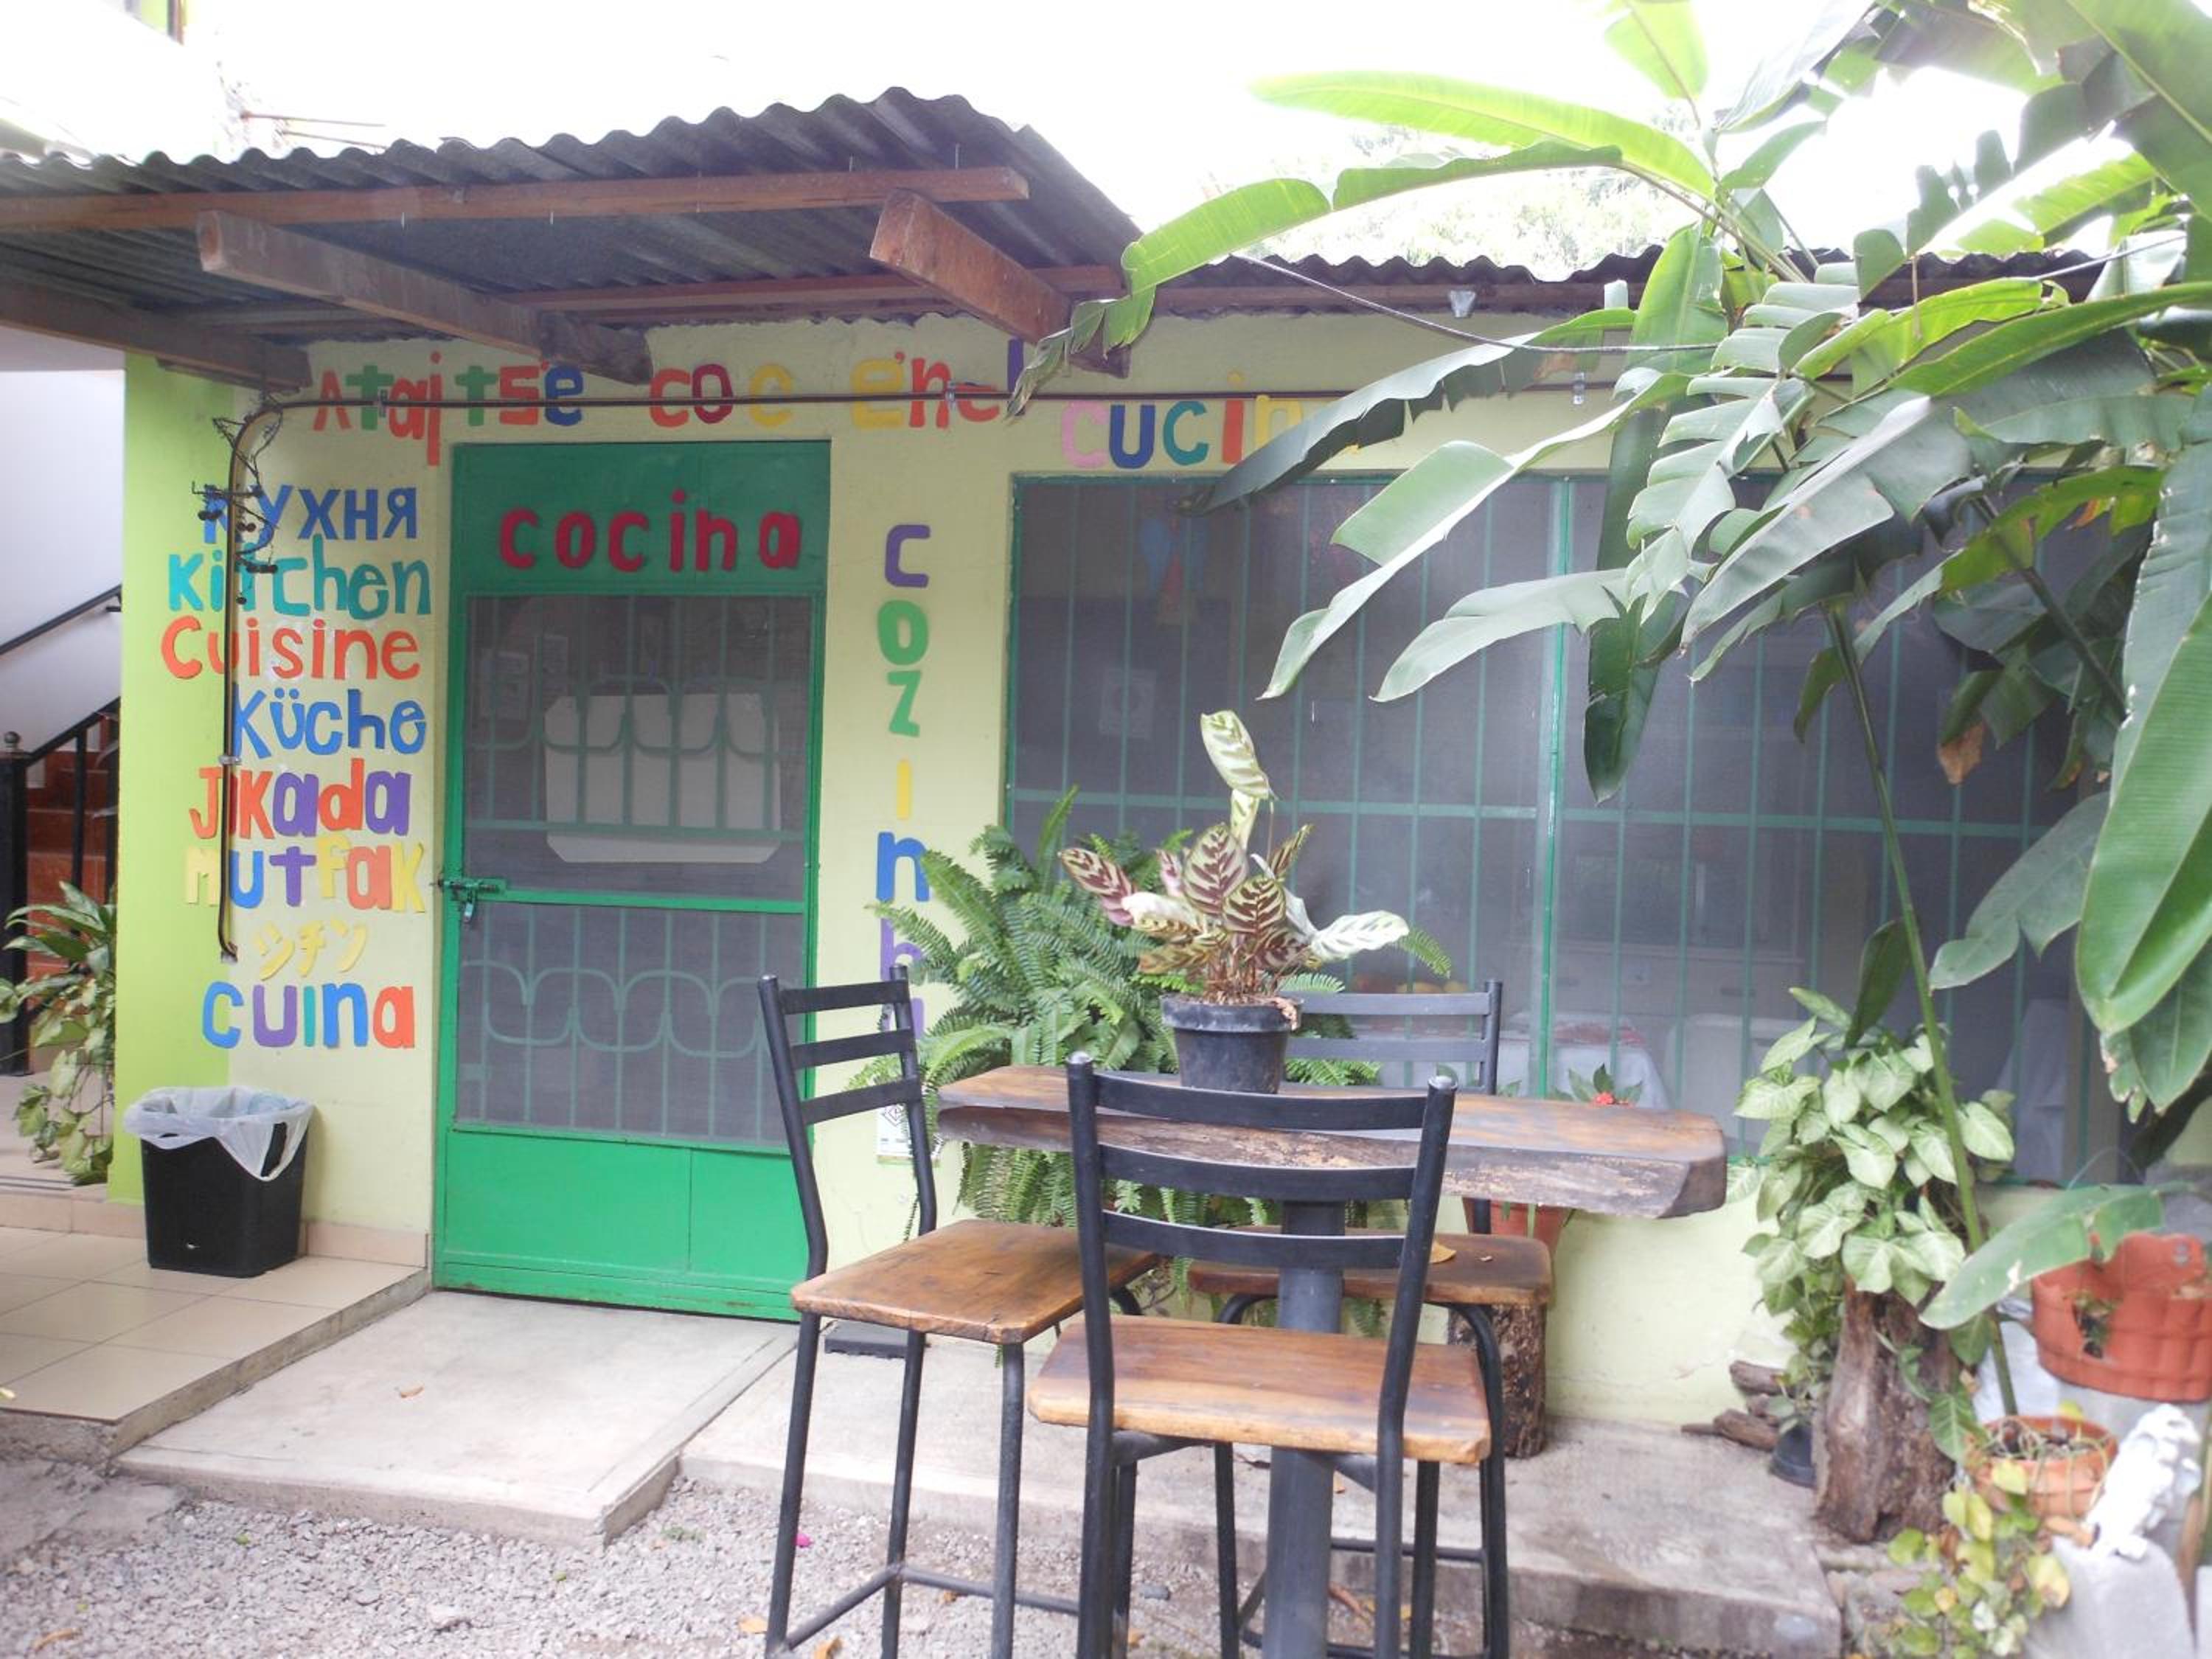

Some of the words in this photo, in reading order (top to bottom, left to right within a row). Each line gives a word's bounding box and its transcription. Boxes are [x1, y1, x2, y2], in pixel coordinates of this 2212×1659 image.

[1062, 370, 1360, 469] cucin
[499, 489, 801, 572] cocina
[168, 534, 431, 619] Kitchen
[161, 615, 421, 680] Cuisine
[233, 681, 427, 759] Küche
